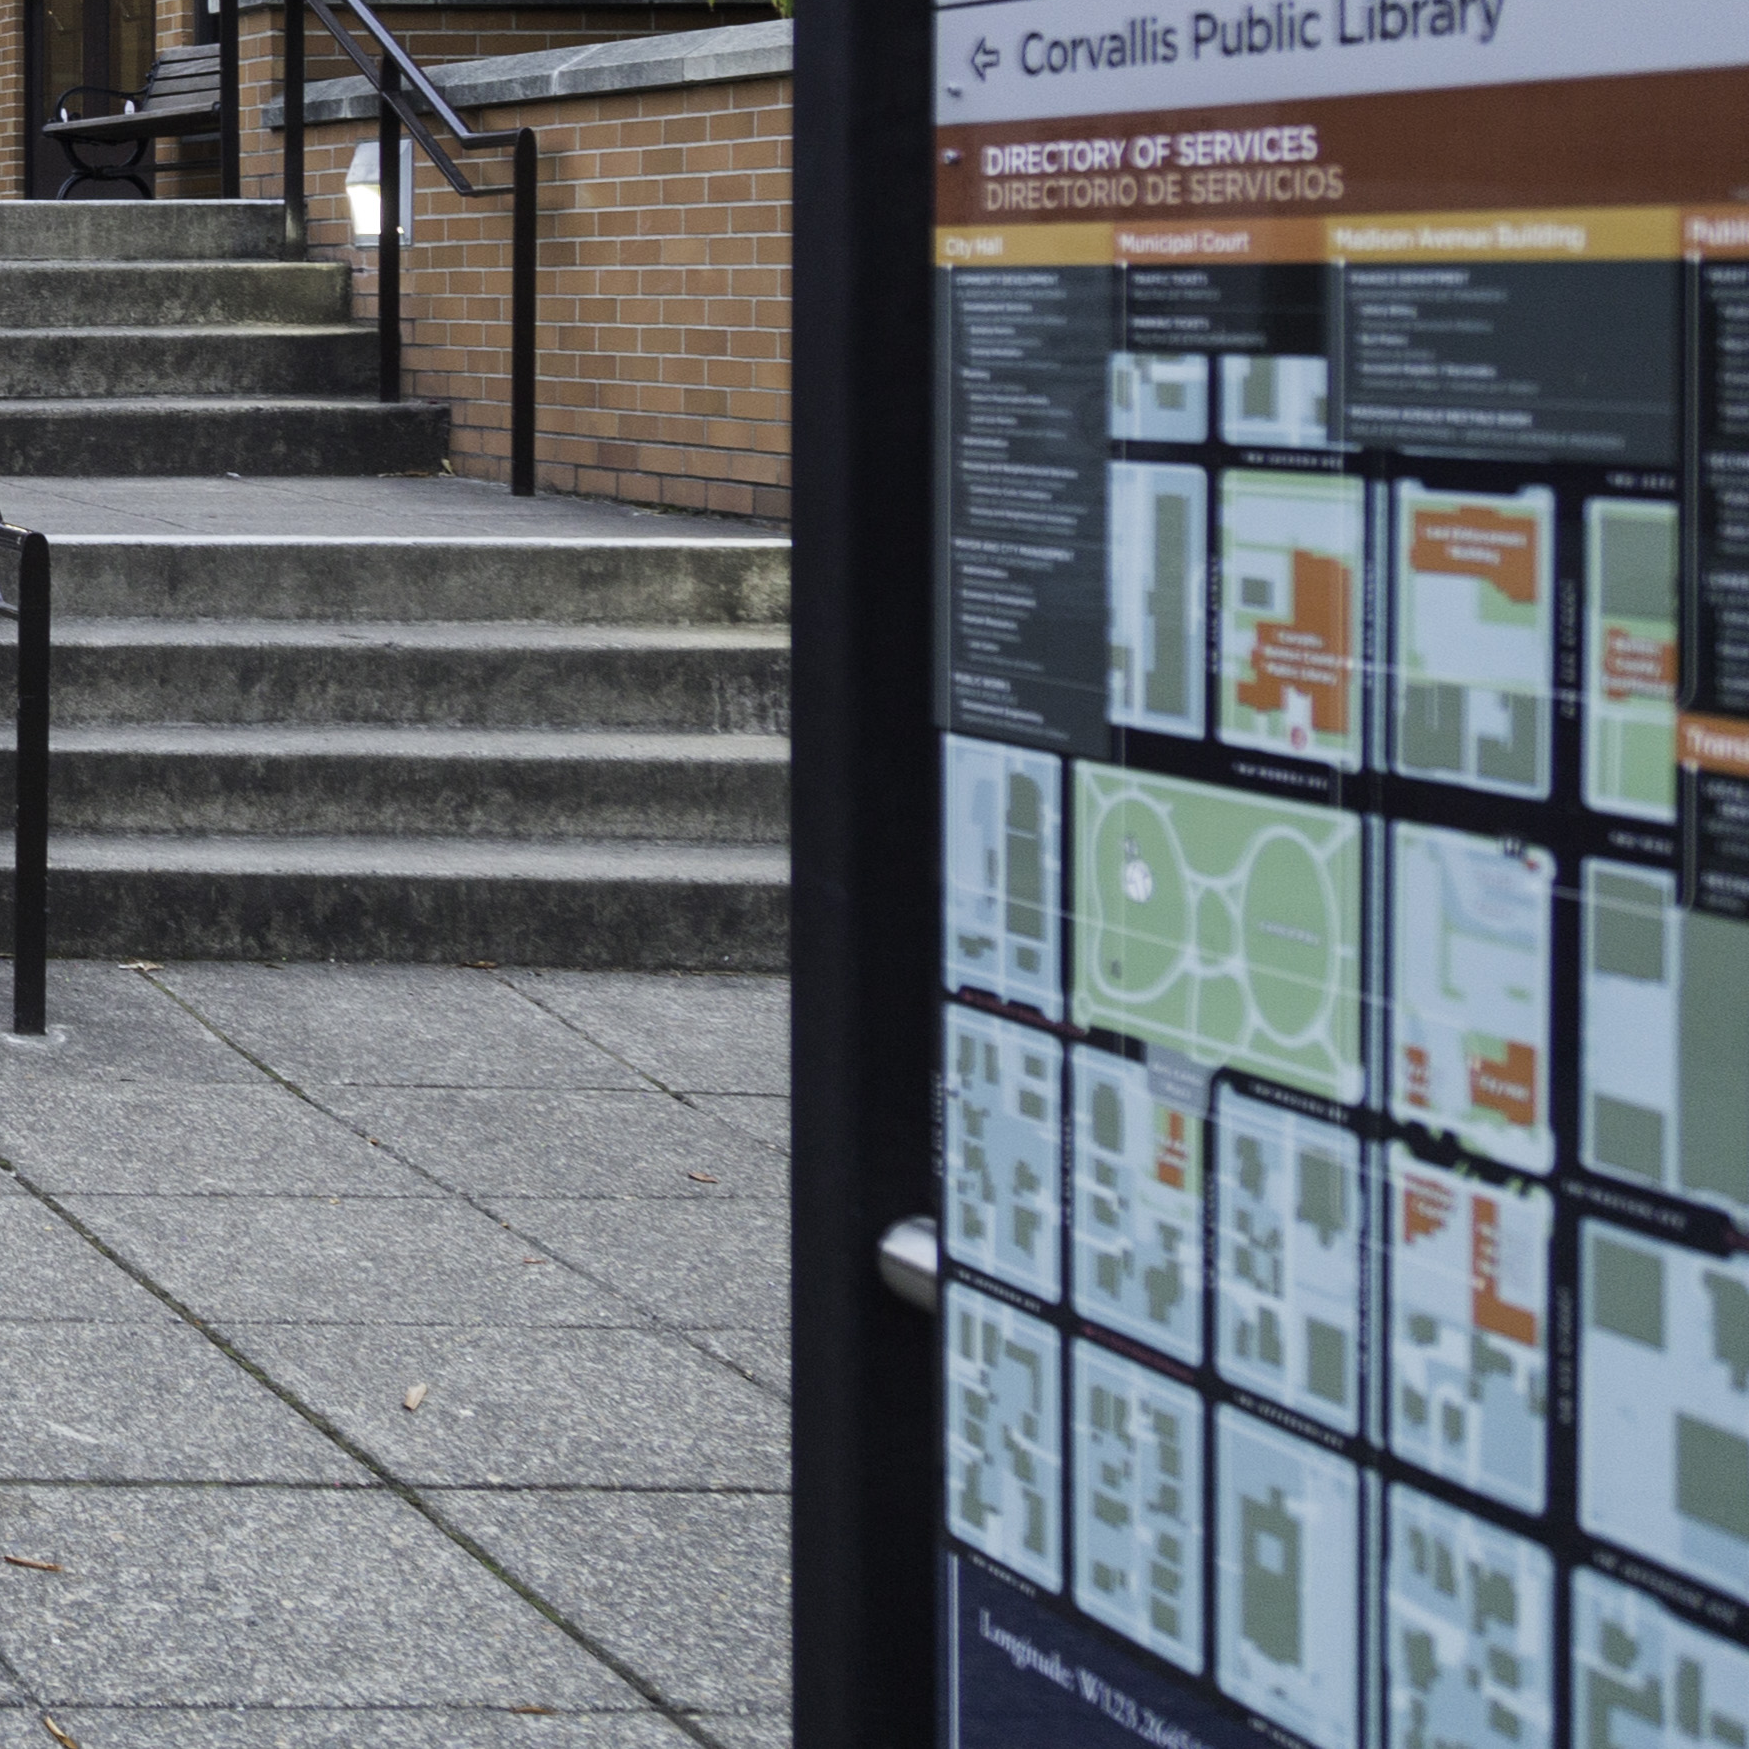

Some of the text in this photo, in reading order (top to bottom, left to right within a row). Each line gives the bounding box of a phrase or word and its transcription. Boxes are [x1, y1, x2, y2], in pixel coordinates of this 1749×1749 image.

[1019, 15, 1180, 76] Corvallis
[1192, 0, 1323, 59] Public
[983, 125, 1319, 177] DIRECTORY OF SERVICES
[984, 165, 1345, 212] DIRECTORIO DE SERVICIOS
[945, 235, 1003, 258] City Hall
[1119, 230, 1250, 254] Municipal Court
